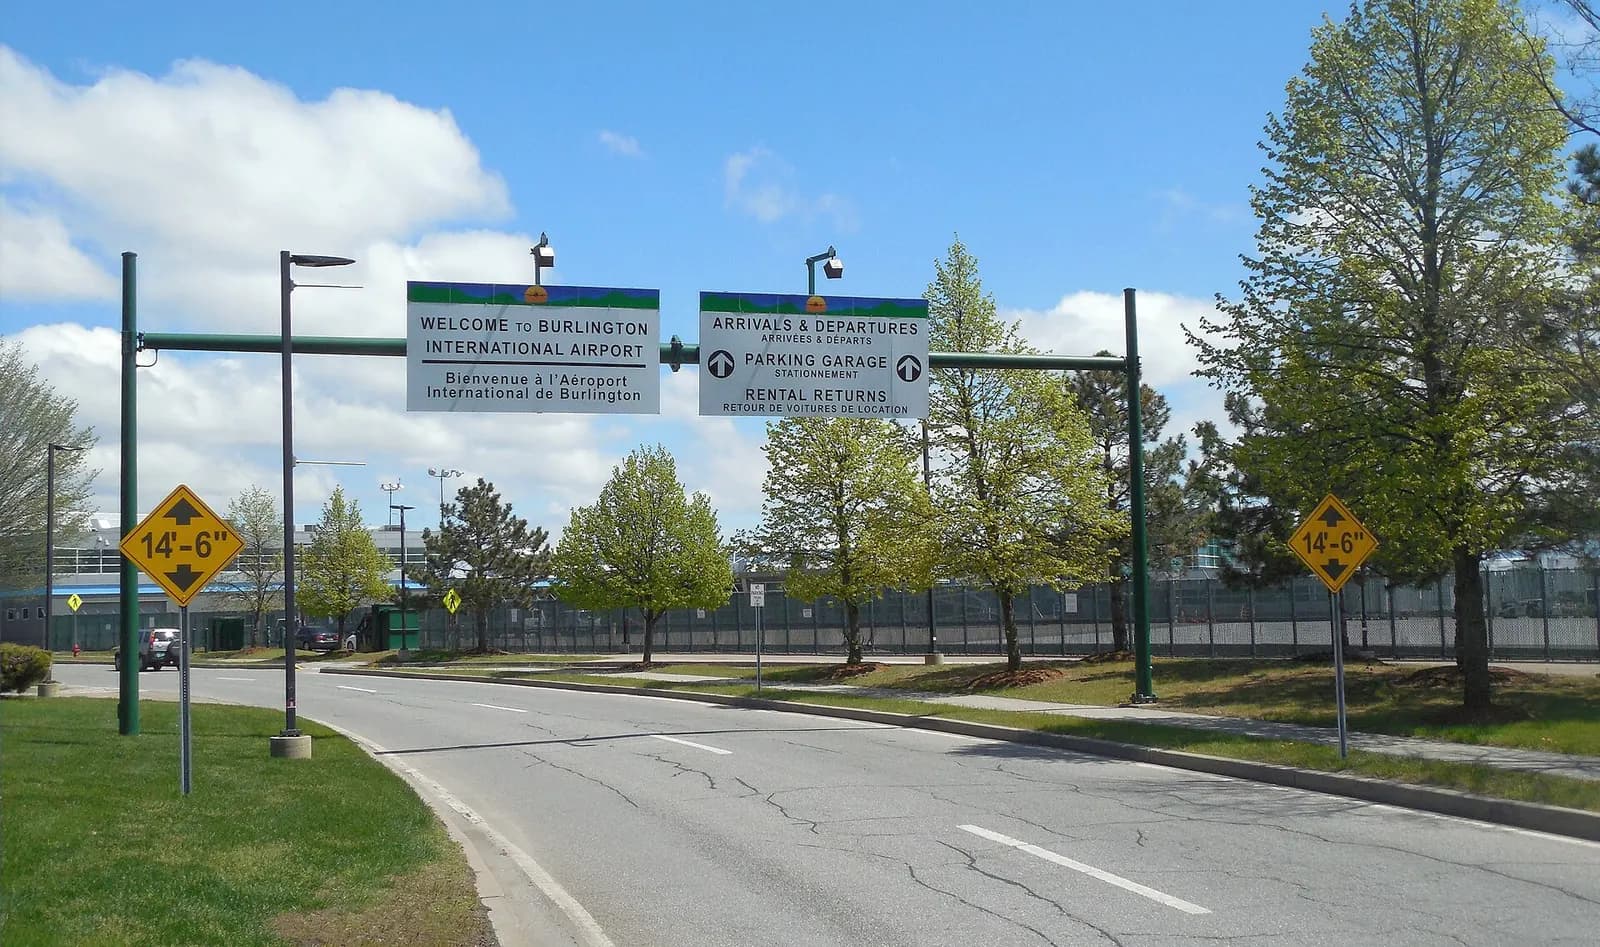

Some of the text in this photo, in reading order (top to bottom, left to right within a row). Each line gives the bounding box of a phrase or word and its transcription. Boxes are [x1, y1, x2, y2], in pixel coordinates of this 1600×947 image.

[420, 317, 648, 336] WELCOME TO BURLINGTON
[712, 317, 918, 335] ARRIVALS & DEPARTURES
[761, 333, 872, 345] ARRIVÉES & DÉPARTS
[426, 340, 644, 358] INTERNATIONAL AIRPORT
[745, 353, 887, 368] PARKING GARAGE
[445, 372, 628, 388] Bienvenue à l'Aéroport
[775, 368, 859, 379] STATIONNEMENT
[427, 386, 641, 404] International de Burlington
[745, 388, 887, 402] RENTAL RETURNS
[723, 403, 908, 414] RETOUR DE VOITURES DE LOCATION
